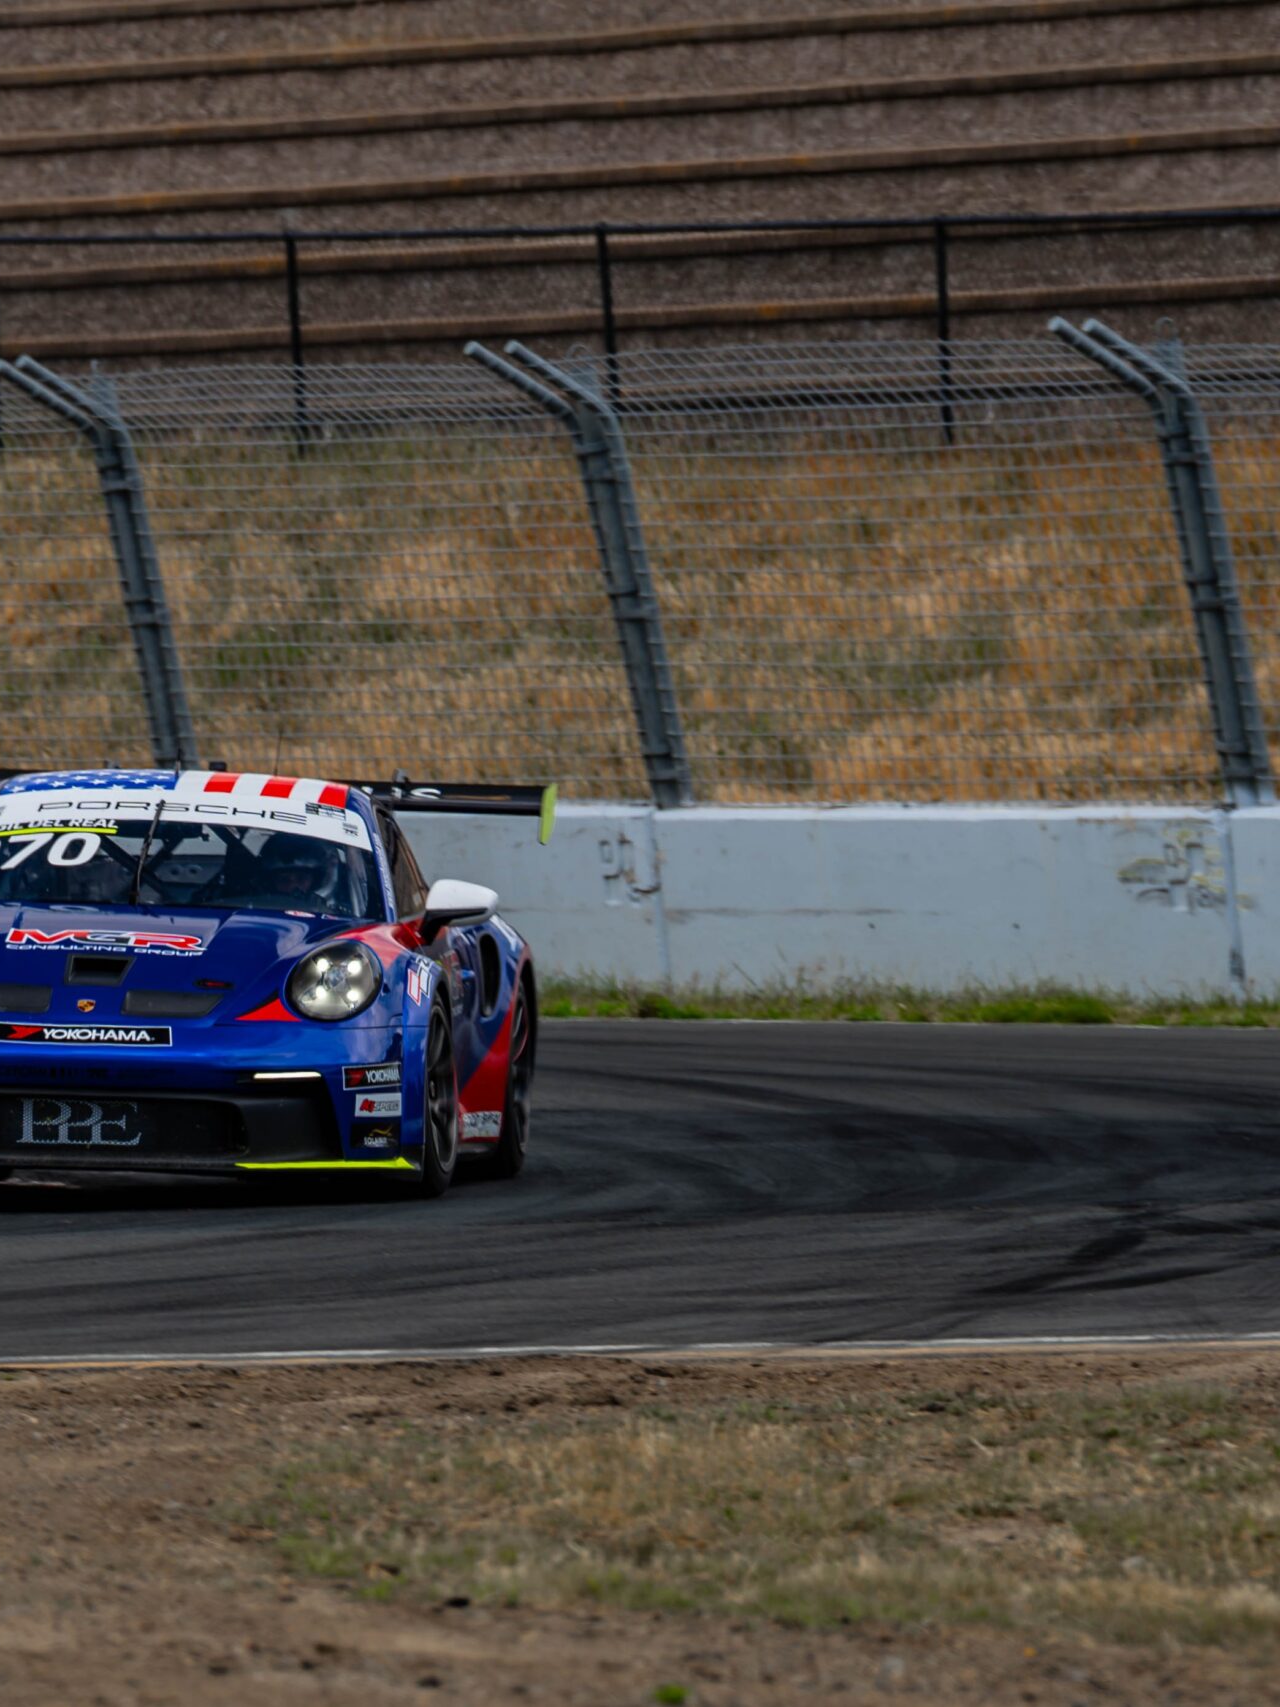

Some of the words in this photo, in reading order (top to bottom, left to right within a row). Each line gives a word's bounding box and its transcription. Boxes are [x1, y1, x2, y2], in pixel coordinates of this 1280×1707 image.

[38, 800, 307, 825] PORSCHE
[68, 818, 119, 829] REAL
[5, 943, 127, 953] CONSULTING
[133, 947, 204, 957] GROUP
[42, 1027, 153, 1042] YOKOHAMA
